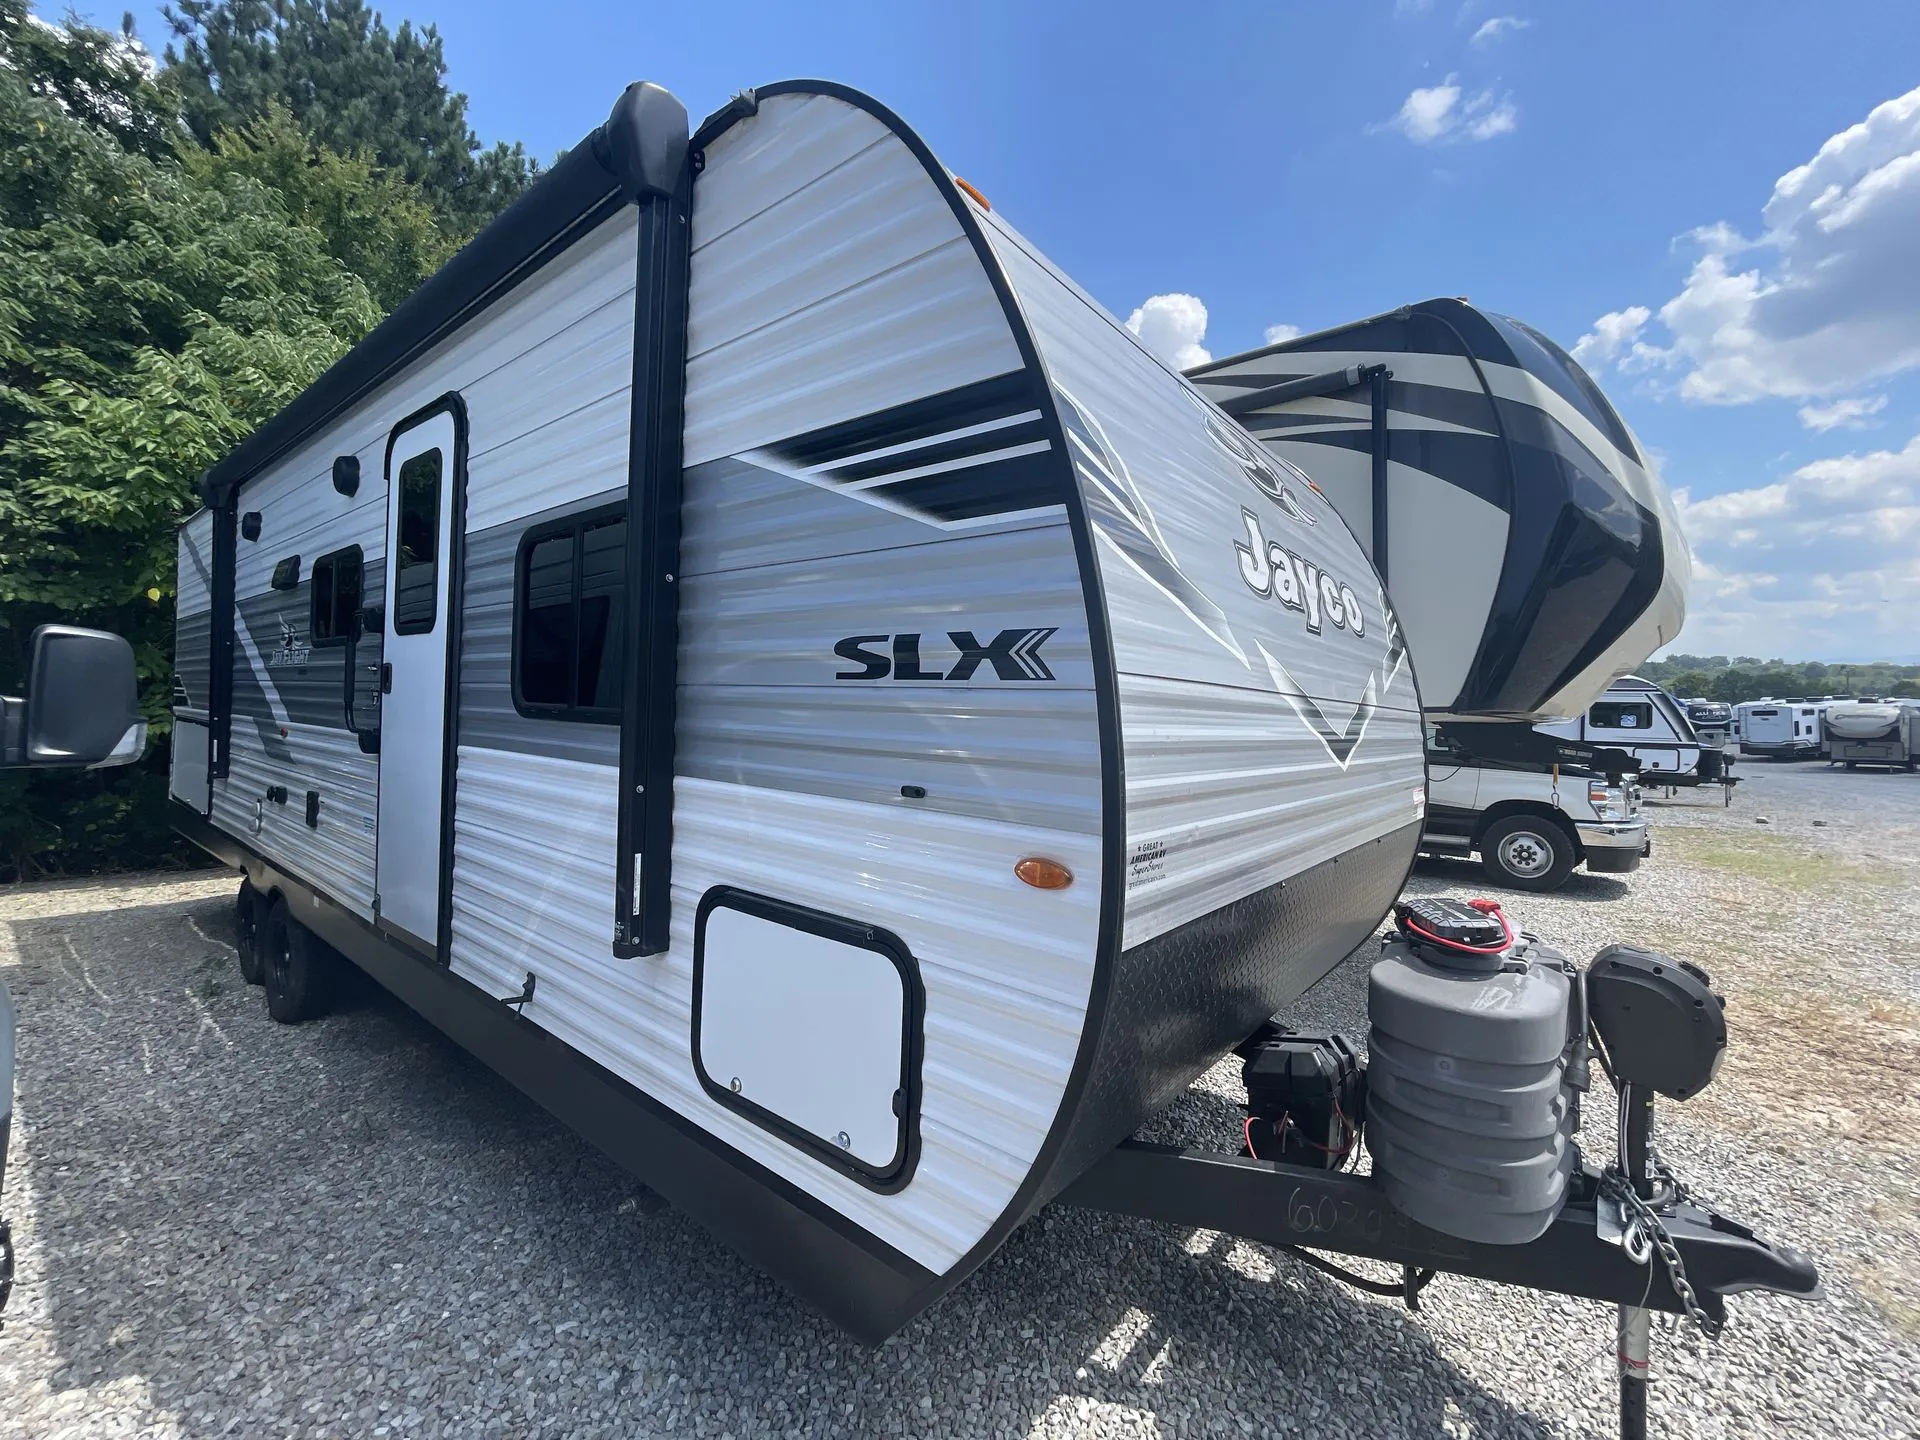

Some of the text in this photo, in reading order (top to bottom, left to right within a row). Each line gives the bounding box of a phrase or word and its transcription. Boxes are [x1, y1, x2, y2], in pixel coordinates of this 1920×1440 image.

[1233, 504, 1365, 638] Jayco
[833, 627, 1060, 680] SLX
[1130, 849, 1167, 865] AMERICAN RV
[1142, 841, 1159, 852] GREAT
